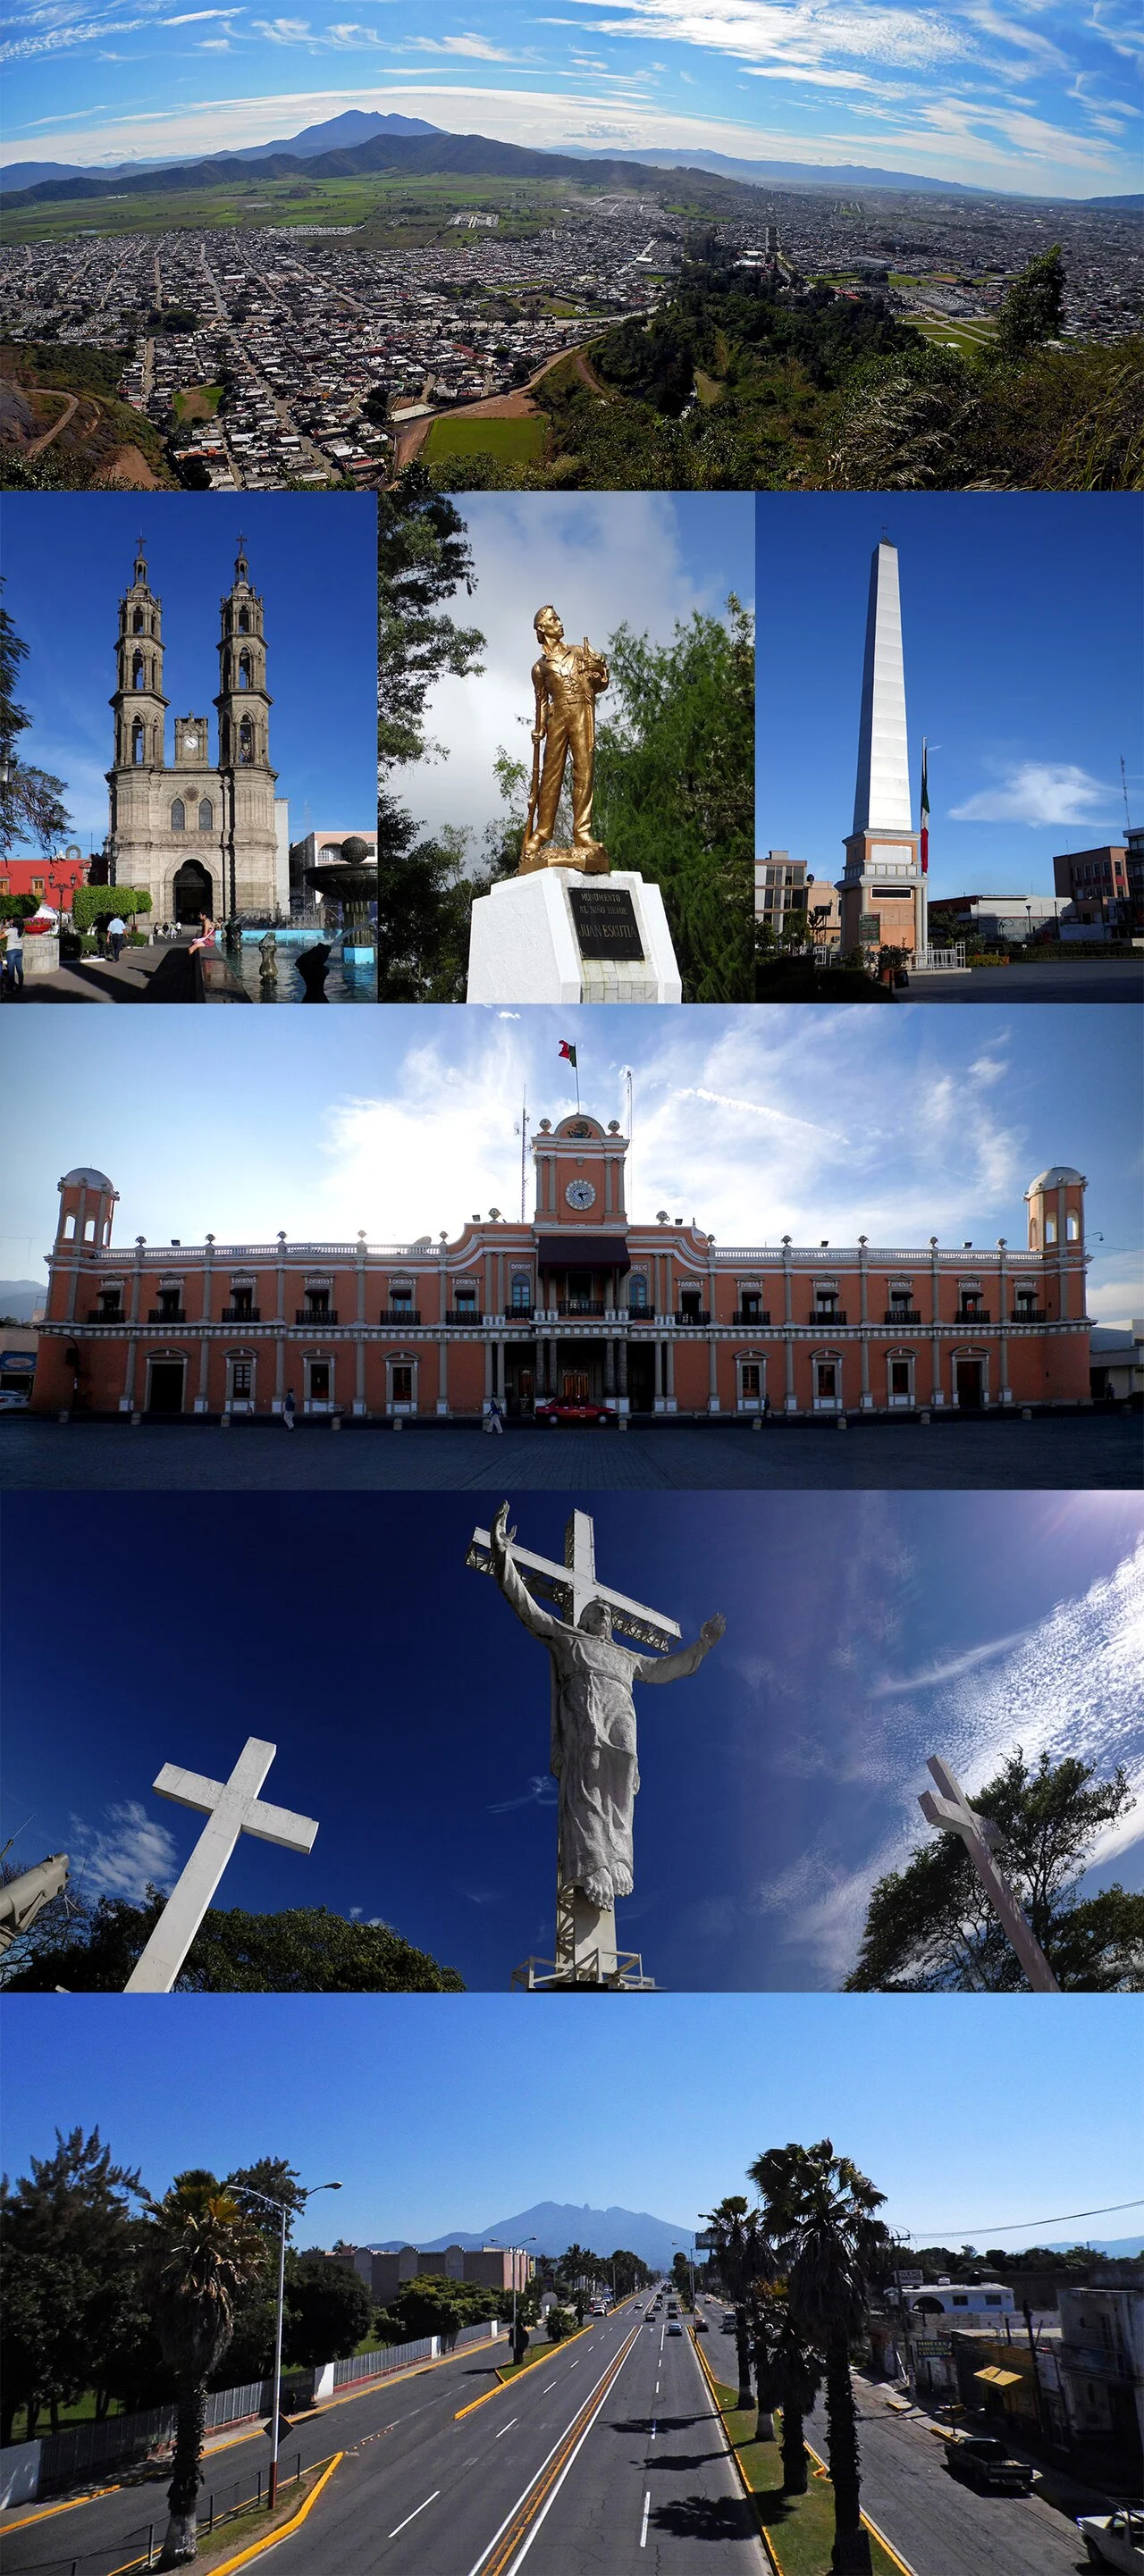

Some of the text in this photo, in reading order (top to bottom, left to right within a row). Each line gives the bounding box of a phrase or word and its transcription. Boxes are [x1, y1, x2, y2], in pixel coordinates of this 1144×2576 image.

[580, 893, 620, 902] MONUMENTO
[579, 905, 589, 914] AL
[579, 924, 637, 938] JUAN ESCUTIA
